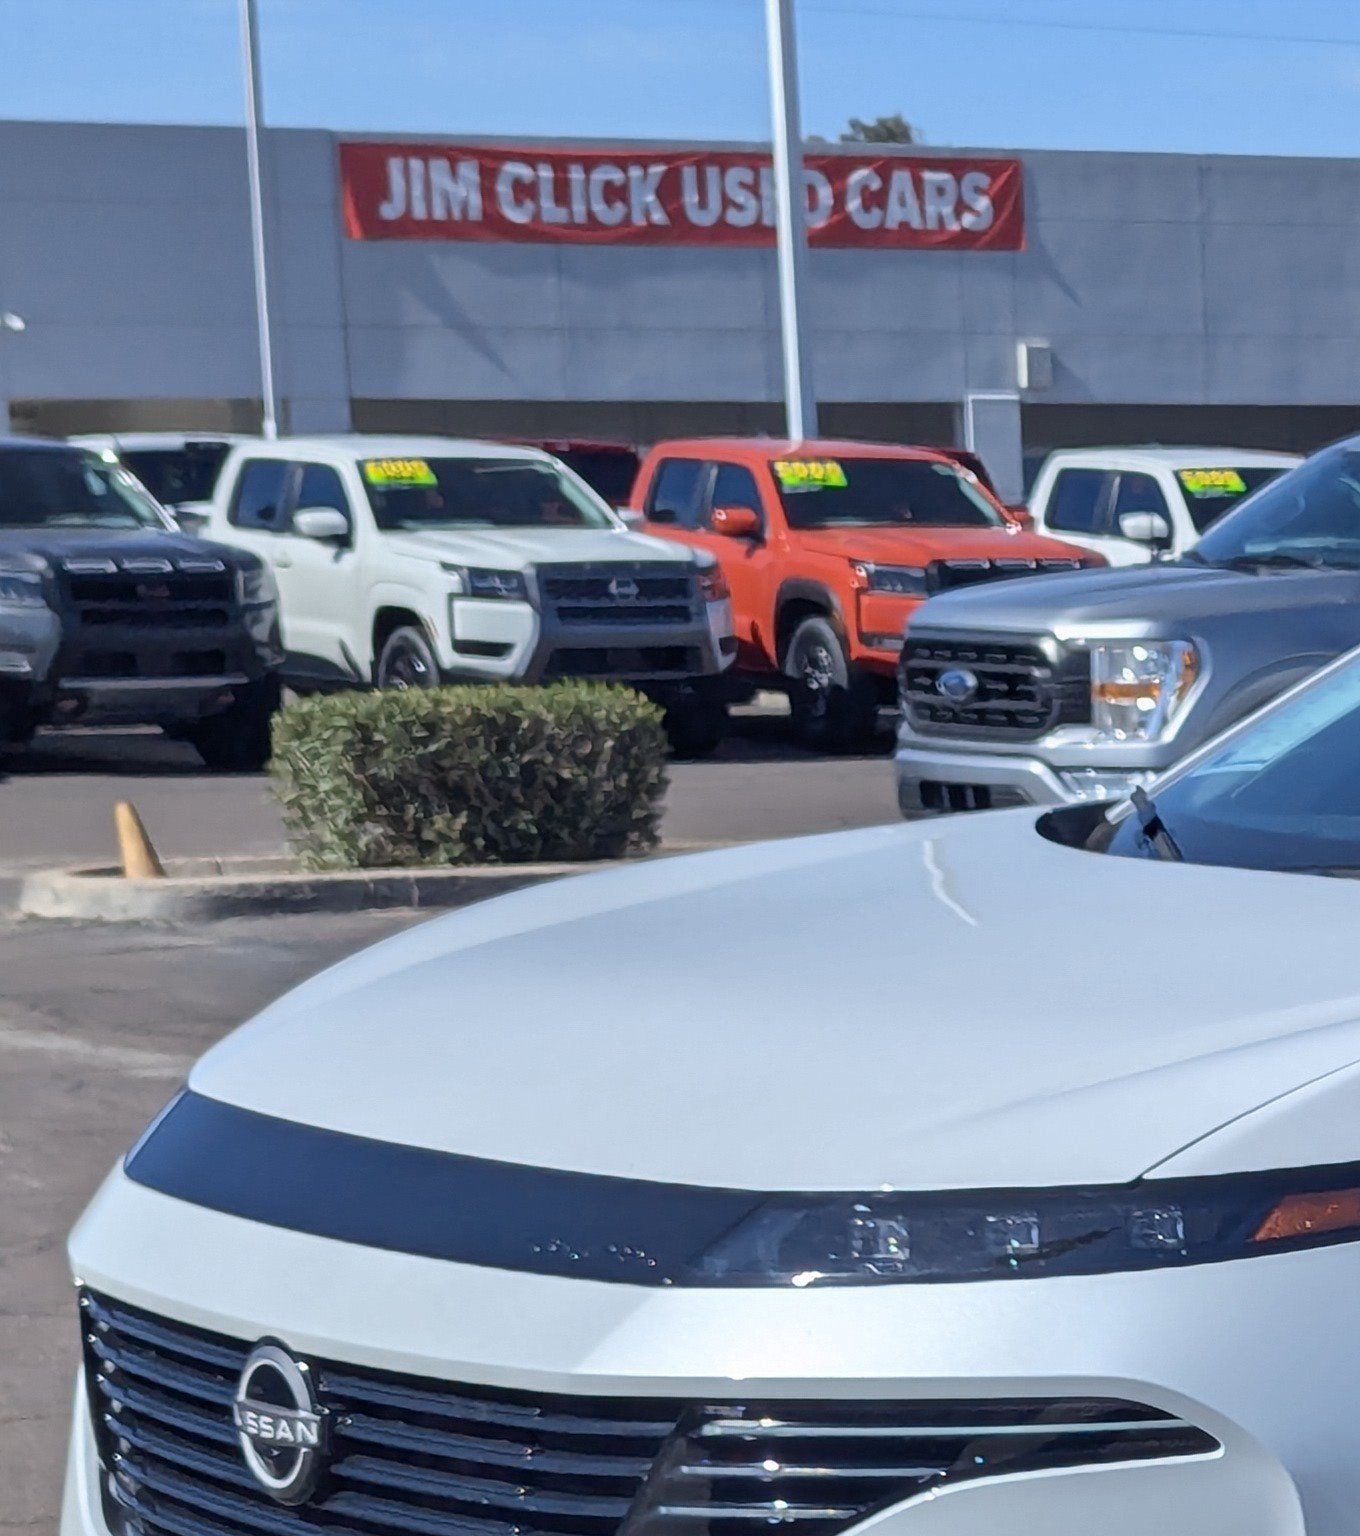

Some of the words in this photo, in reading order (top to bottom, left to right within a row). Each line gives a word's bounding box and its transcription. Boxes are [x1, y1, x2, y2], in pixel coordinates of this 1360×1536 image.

[379, 157, 483, 221] JIM
[495, 161, 671, 226] CLICK
[845, 168, 995, 231] CARS
